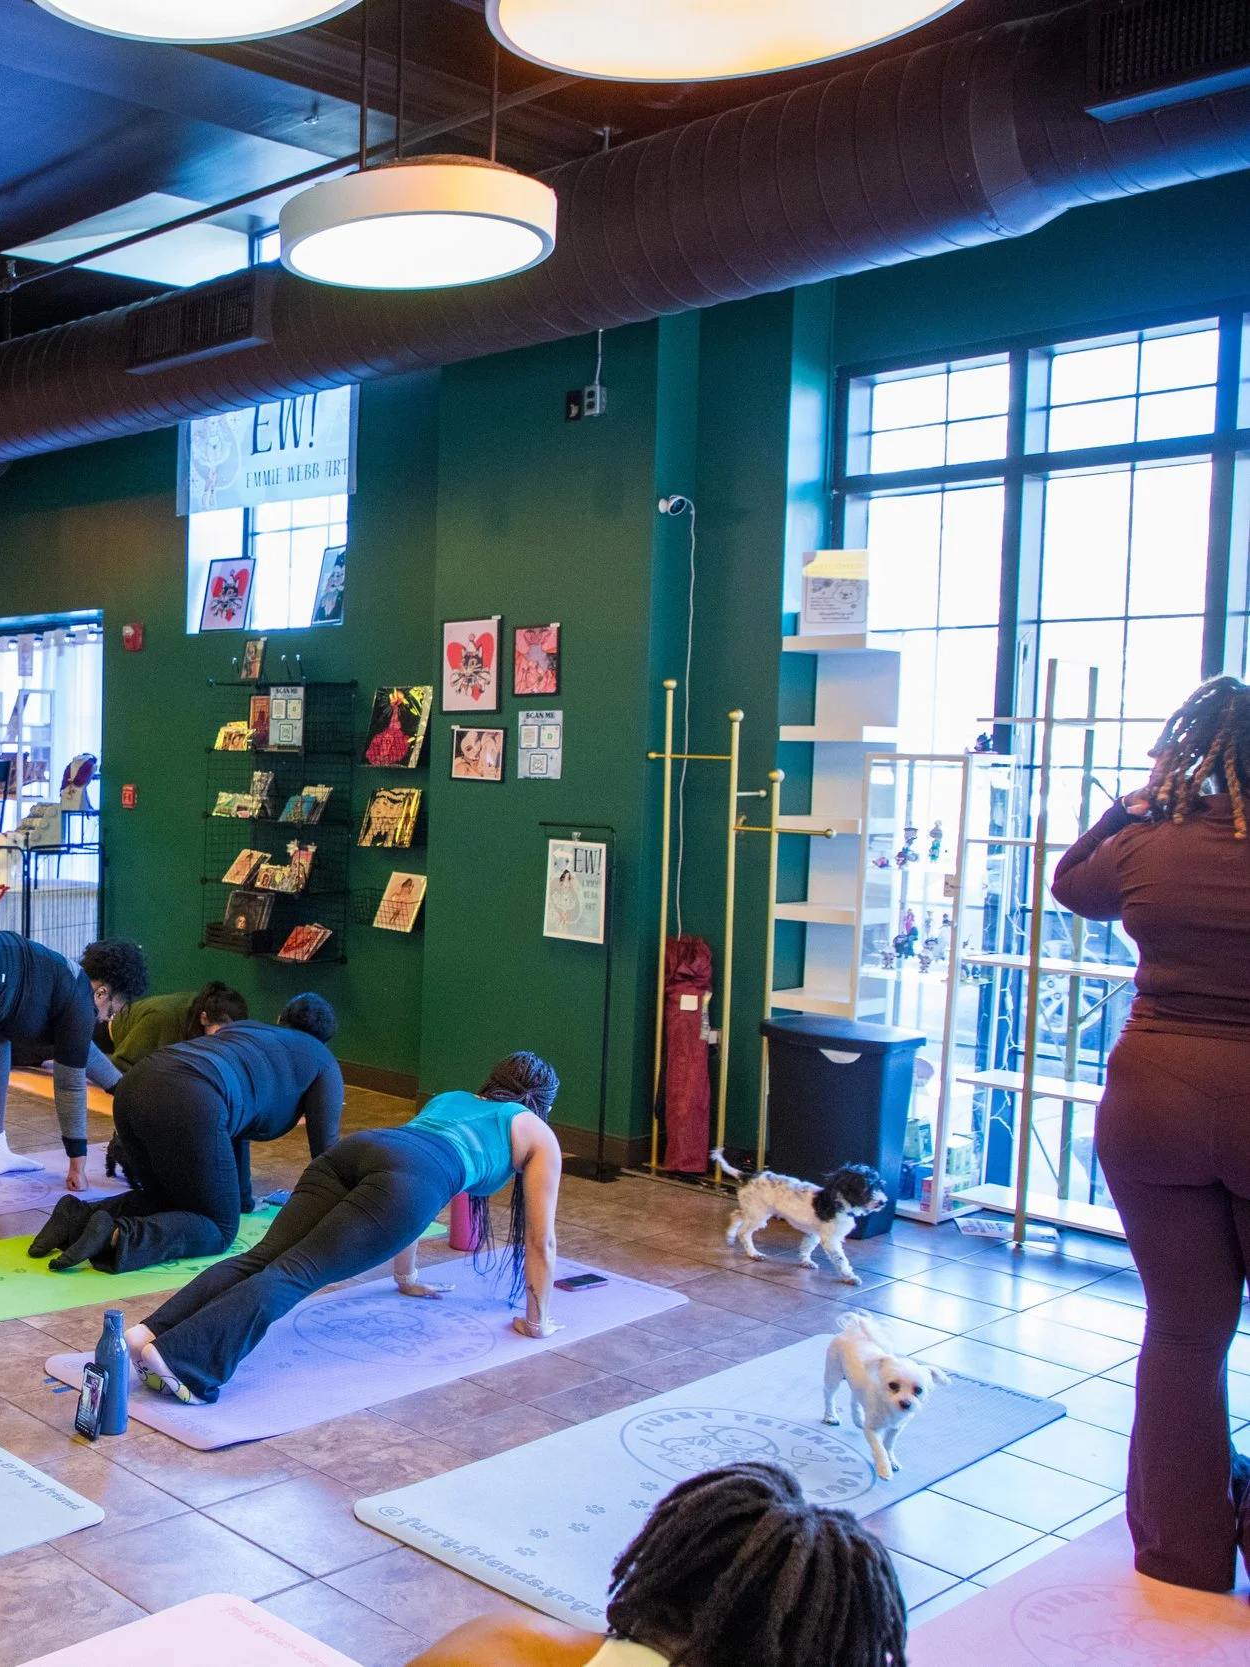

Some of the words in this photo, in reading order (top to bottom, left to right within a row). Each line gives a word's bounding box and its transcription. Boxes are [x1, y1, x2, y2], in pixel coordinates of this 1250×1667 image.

[251, 393, 318, 455] EW!
[245, 467, 283, 489] EMMIE
[287, 462, 320, 483] WEBB
[324, 458, 349, 480] ART
[573, 848, 603, 876] EW!
[635, 1410, 715, 1434] FURRY
[7, 1466, 44, 1490] furry
[38, 1486, 85, 1512] friend
